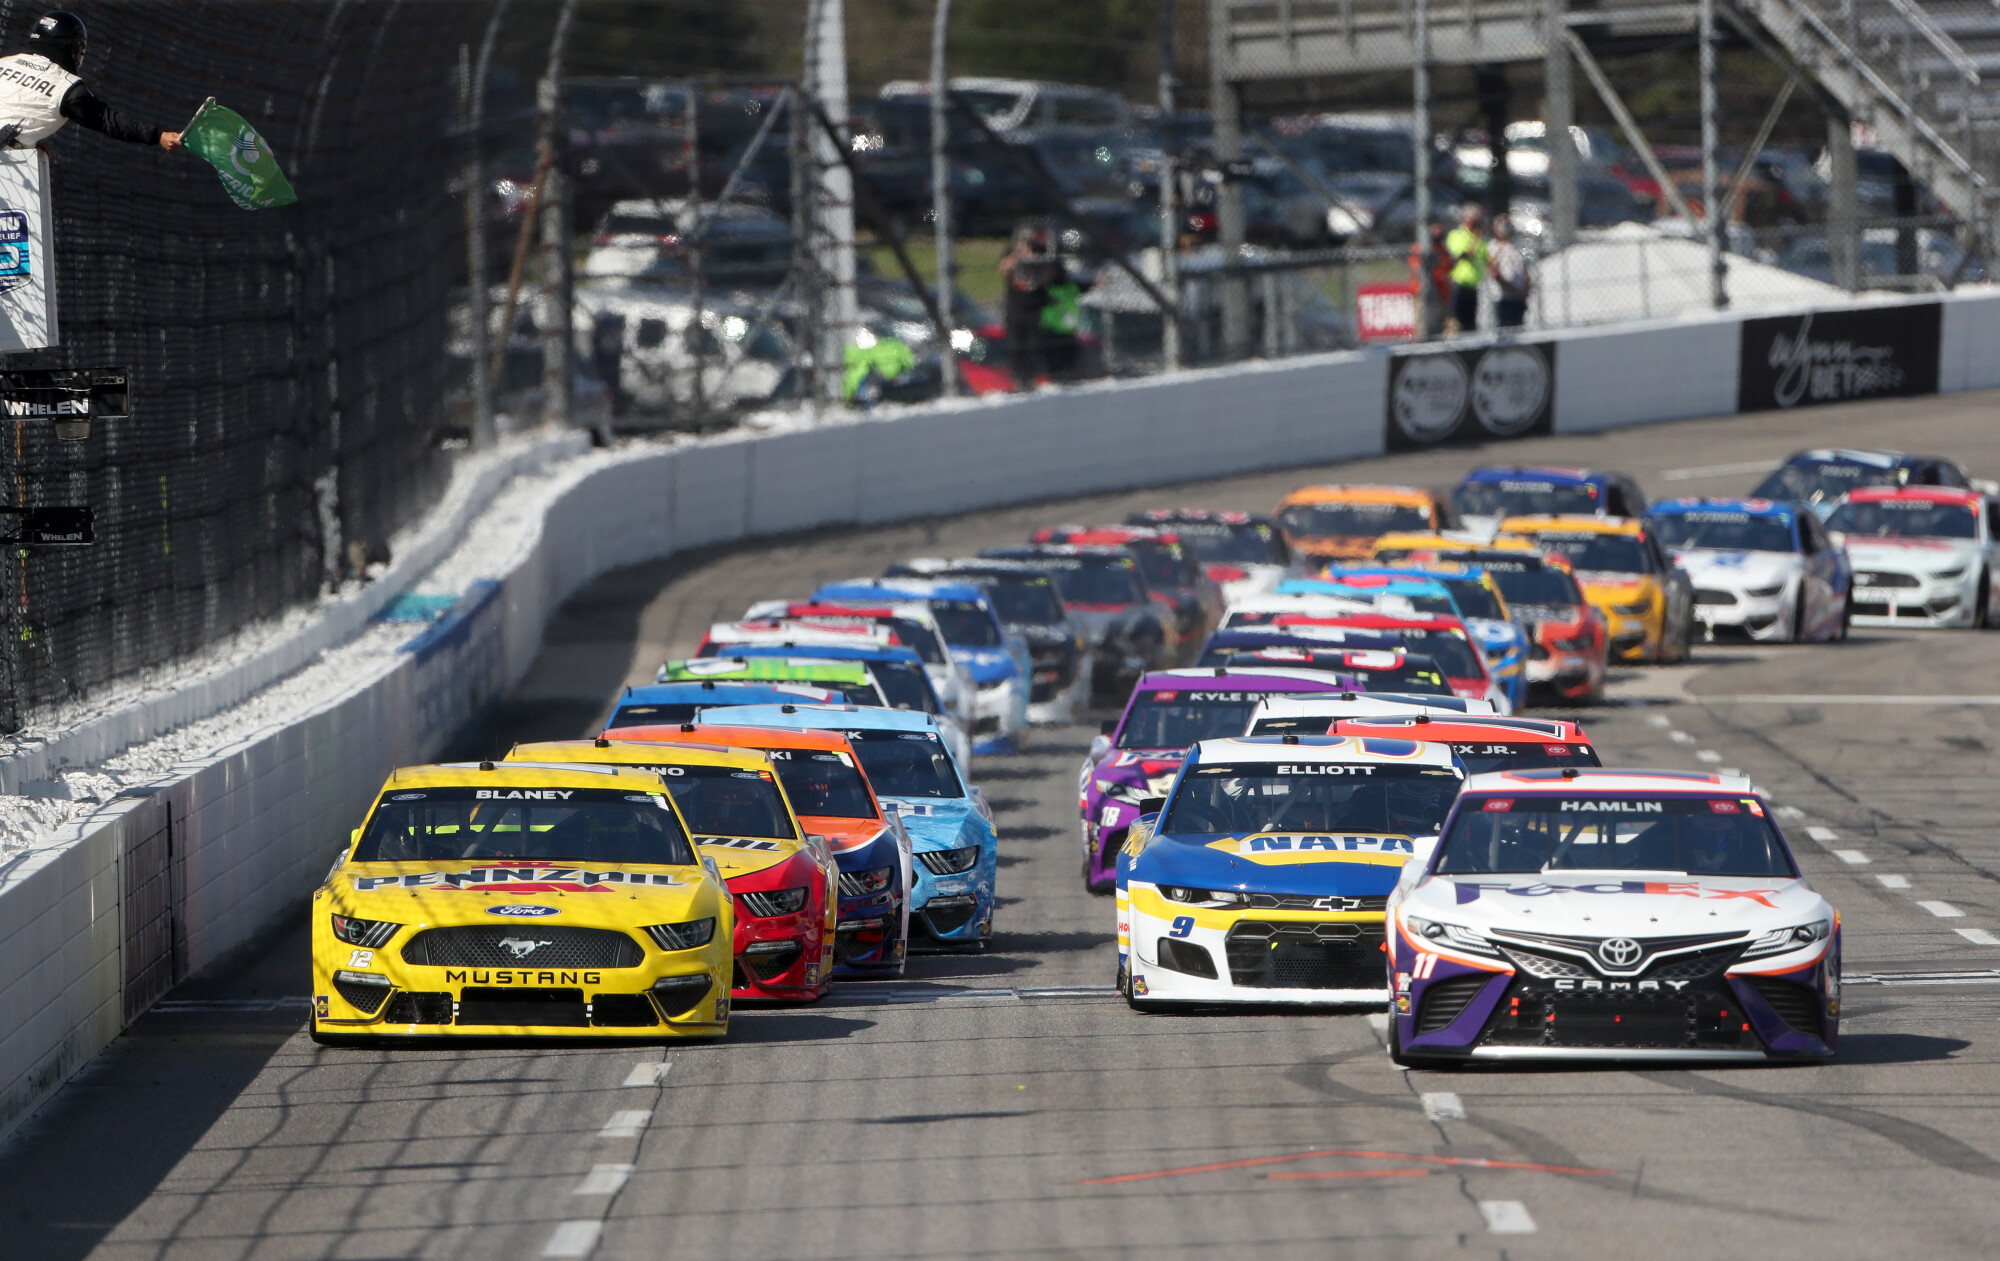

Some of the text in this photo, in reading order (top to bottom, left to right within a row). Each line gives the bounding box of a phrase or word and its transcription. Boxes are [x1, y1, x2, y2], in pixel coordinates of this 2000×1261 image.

[0, 66, 57, 97] FFICIAL
[4, 398, 89, 416] WHELEN
[41, 532, 82, 541] WHELEN
[1190, 692, 1241, 702] KYLE
[1481, 745, 1517, 755] JR.
[1277, 765, 1376, 775] ELLIOTT
[475, 790, 574, 800] BLANEY
[1560, 801, 1663, 812] HAMLIN
[1101, 806, 1121, 827] 18
[1250, 836, 1414, 853] NAPA
[353, 868, 691, 891] PENNZOIL
[500, 905, 546, 915] Ford
[1168, 916, 1195, 938] 9
[347, 949, 374, 969] 12
[1412, 952, 1440, 979] 11
[445, 970, 601, 985] MUSTANG
